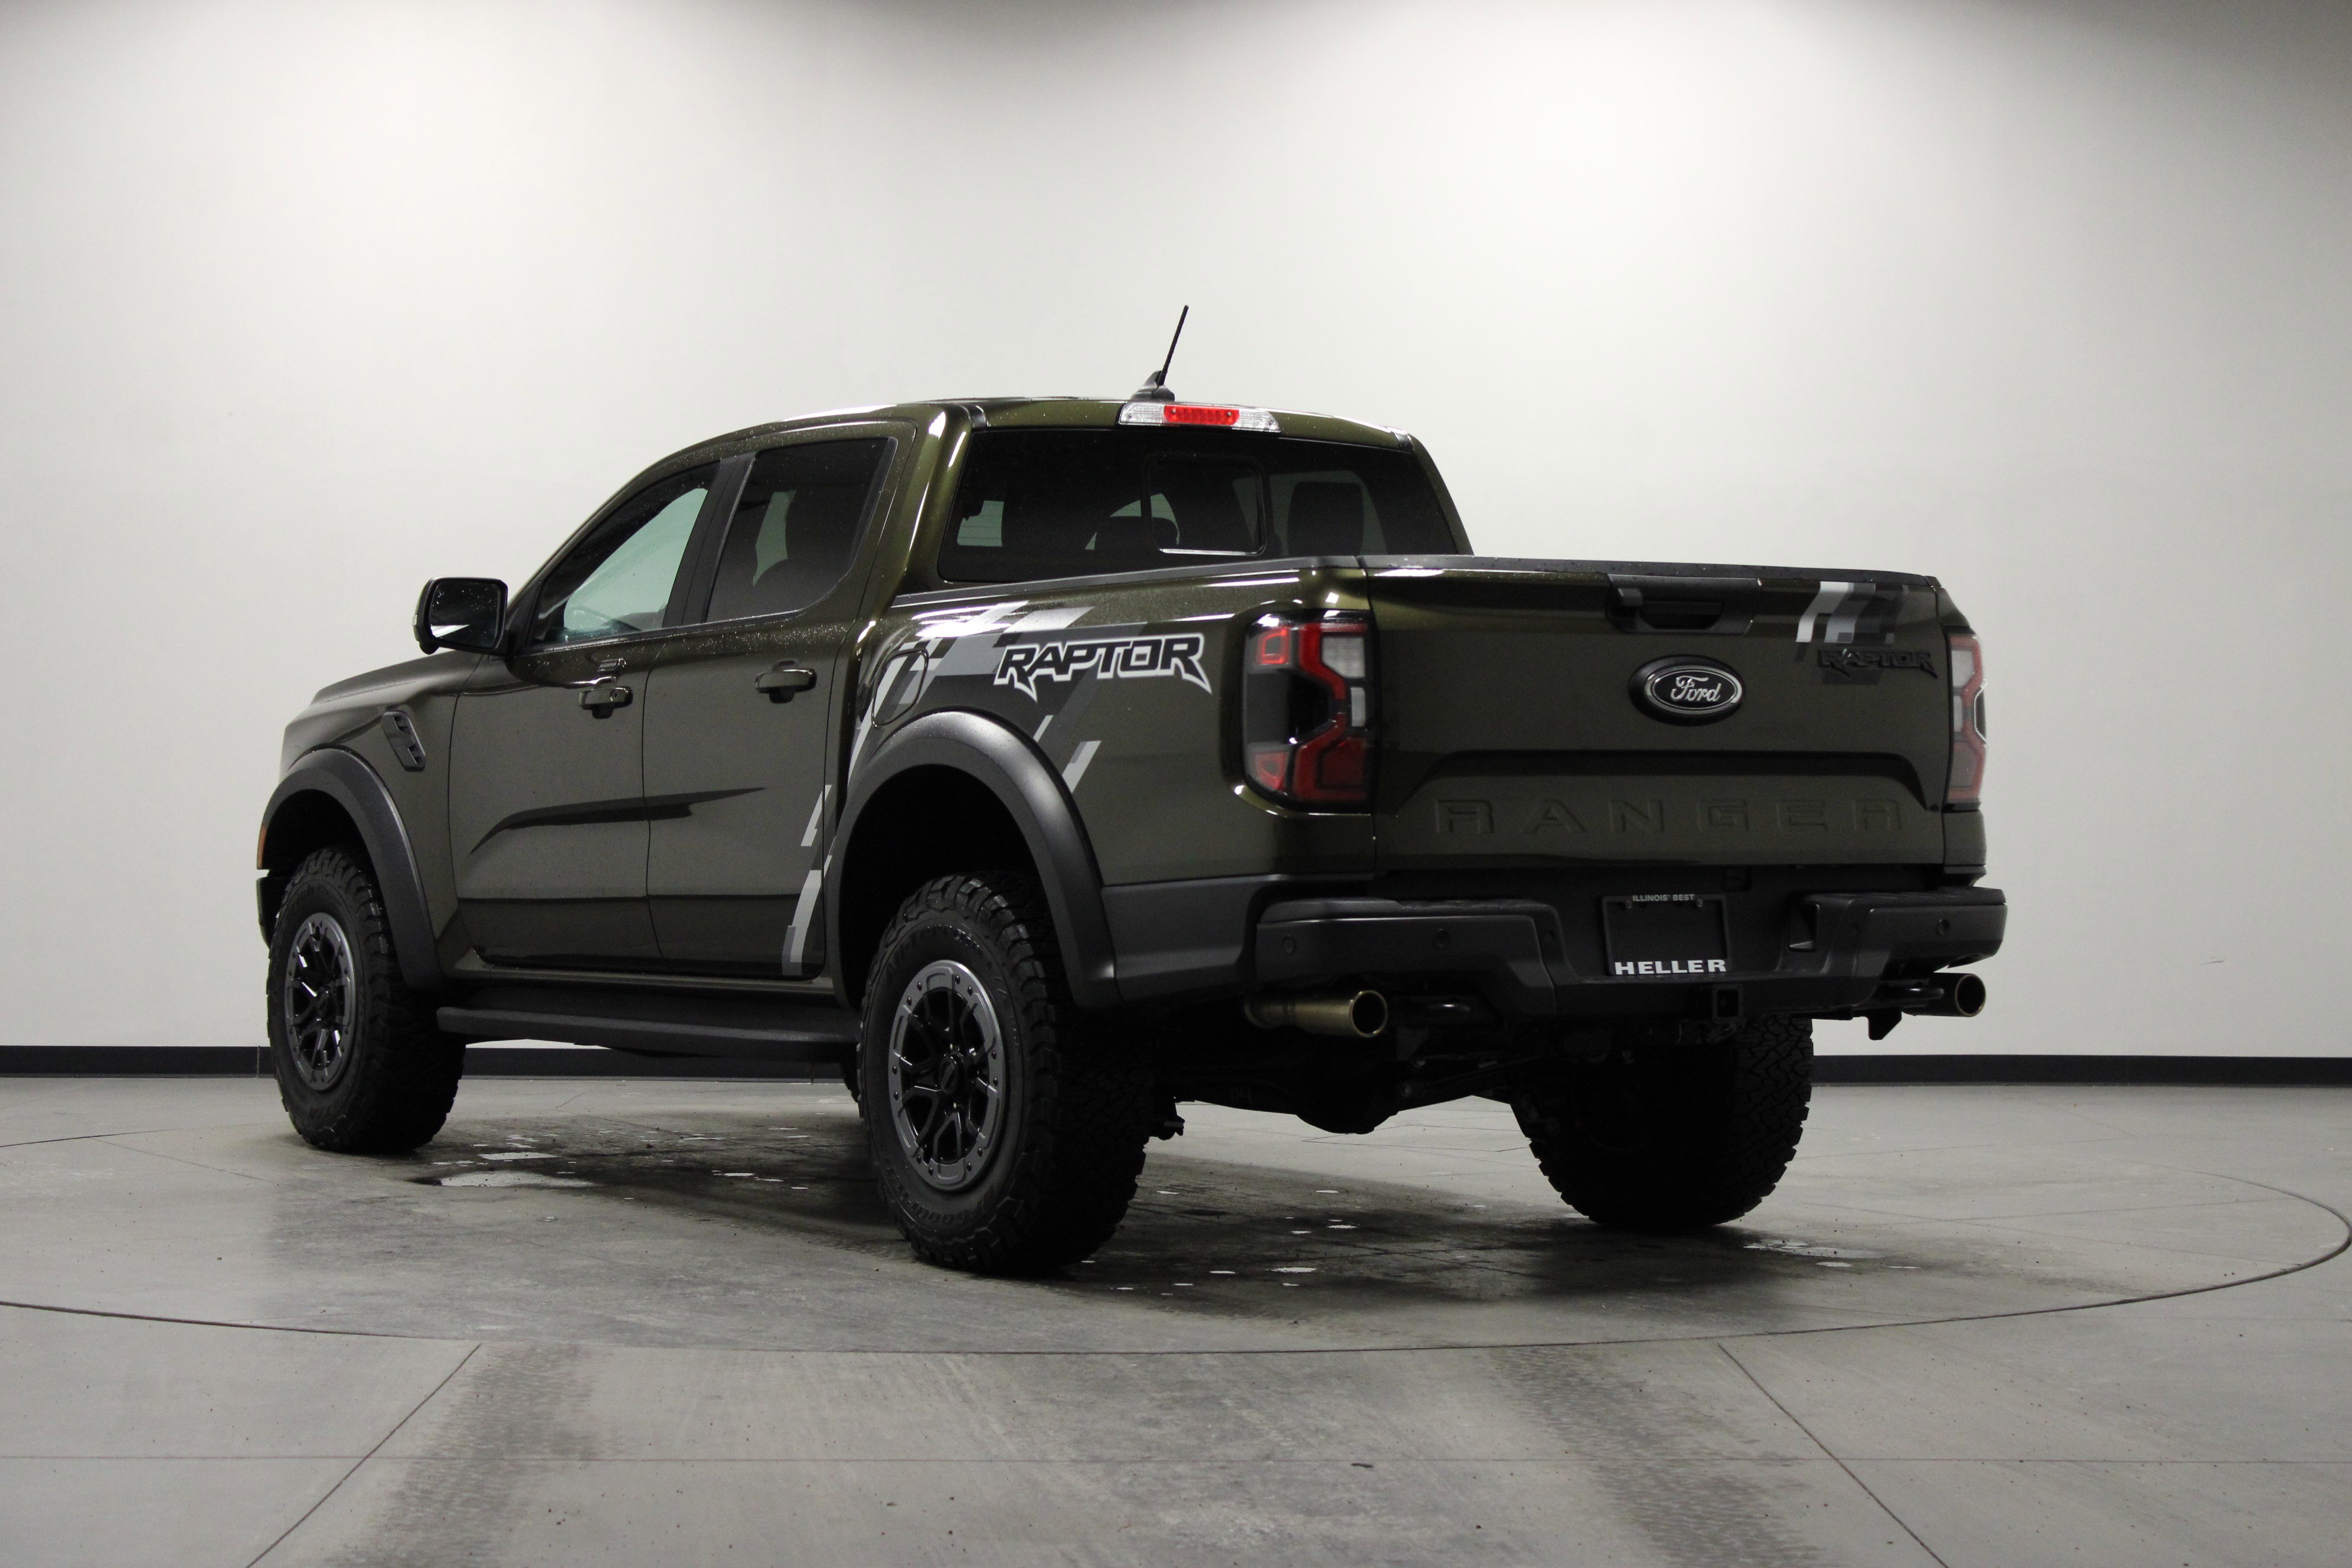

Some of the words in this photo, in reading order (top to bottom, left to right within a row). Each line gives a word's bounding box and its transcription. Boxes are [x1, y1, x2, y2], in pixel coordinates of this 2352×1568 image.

[993, 633, 1213, 702] RAPTOR
[1818, 649, 1938, 678] RAPTOR
[1670, 675, 1721, 702] Ford
[1435, 798, 1903, 834] RANGER
[1615, 959, 1727, 975] HELLER
